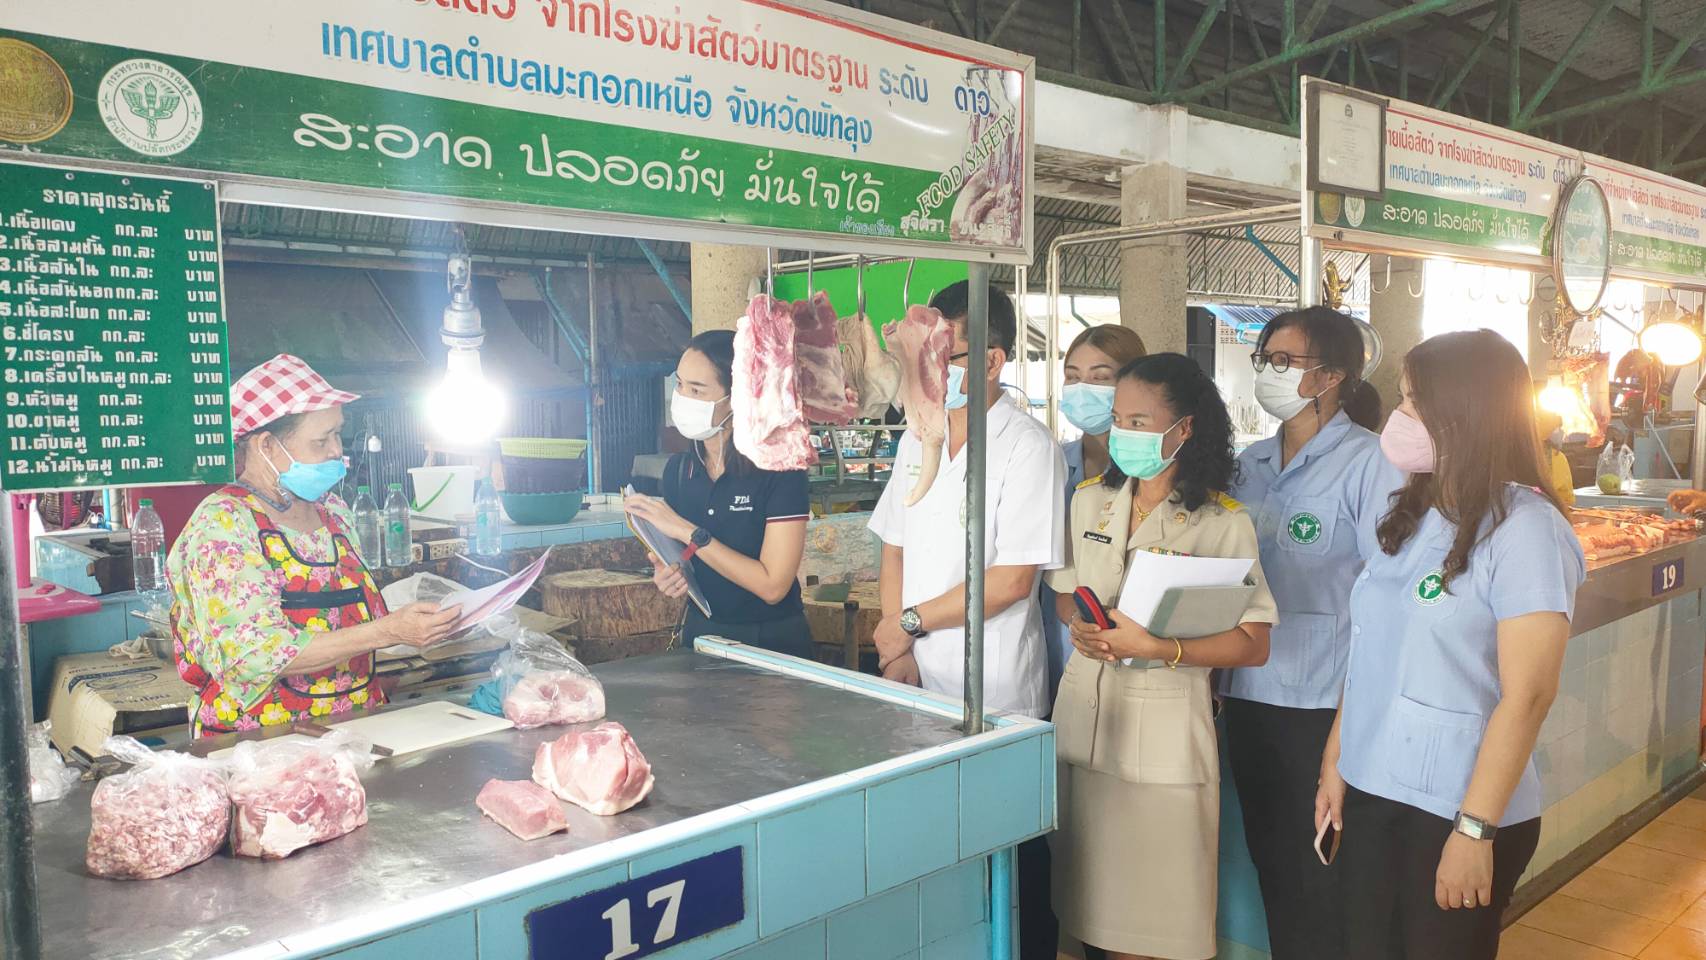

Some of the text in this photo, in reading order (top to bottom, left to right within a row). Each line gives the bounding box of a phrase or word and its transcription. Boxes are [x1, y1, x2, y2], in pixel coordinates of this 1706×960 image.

[321, 22, 873, 152] เทศบาลตำบลมะกอกเหนือ จังหวัดพัทลุง
[880, 64, 929, 103] ระดับ
[955, 86, 990, 115] ดาว
[1386, 120, 1434, 155] ายเนื้อสัตว์
[294, 112, 884, 214] สะอาด ปลอดภัย มั่นใจได้
[917, 109, 1016, 217] FOOD SAFETY
[43, 189, 172, 213] ราคาสุกรวันนี้
[1382, 204, 1427, 225] สะอาด
[116, 224, 157, 237] กก.ละ
[185, 229, 213, 241] บาท
[112, 245, 154, 258] กก.ละ
[188, 251, 217, 262] บาท
[111, 266, 152, 278] กก.ละ
[185, 270, 214, 282] บาท
[188, 291, 216, 302] บาท
[108, 309, 150, 321] กก.ละ
[188, 312, 216, 323] บาท
[103, 331, 144, 342] กก.ละ
[190, 332, 218, 344] บาท
[116, 351, 157, 362] กก.ละ
[191, 353, 220, 363] บาท
[194, 373, 222, 383] บาท
[100, 394, 142, 405] กก.ละ
[194, 394, 223, 405] บาท
[100, 415, 143, 426] กก.ละ
[194, 414, 222, 425] บาท
[102, 436, 145, 448] กก.ละ
[195, 433, 224, 444] บาท
[121, 457, 163, 469] กก.ละ
[197, 455, 225, 466] บาท
[1662, 564, 1676, 590] 19
[602, 879, 686, 960] 17
